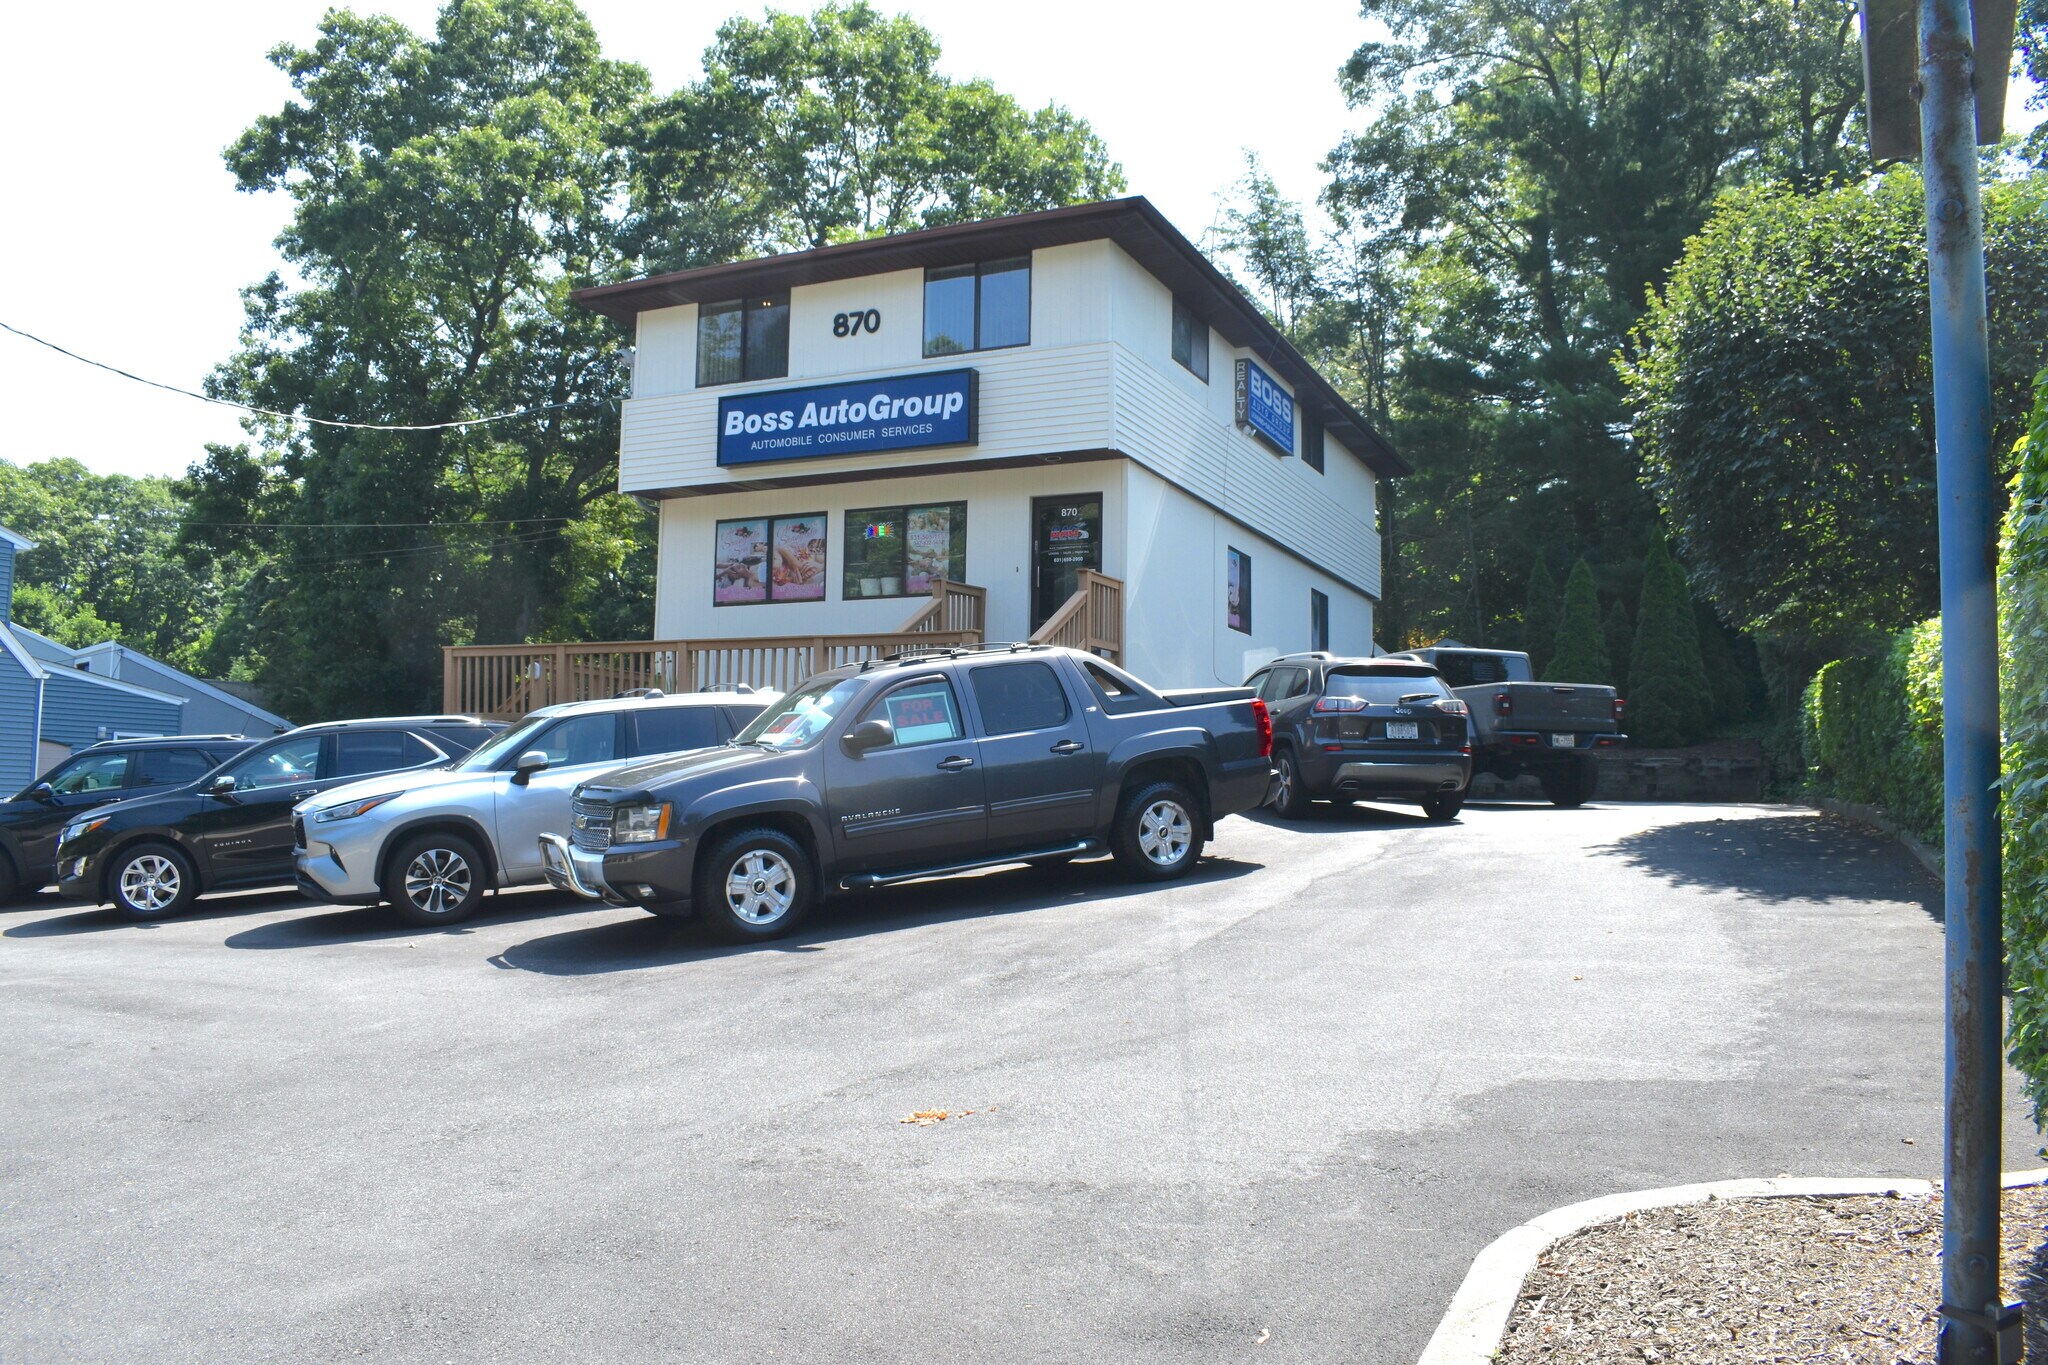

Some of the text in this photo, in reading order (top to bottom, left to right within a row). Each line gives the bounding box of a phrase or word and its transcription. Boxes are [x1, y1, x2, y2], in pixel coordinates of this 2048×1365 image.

[832, 308, 881, 338] 870
[1236, 361, 1246, 419] REALTY
[1250, 368, 1292, 424] BOSS
[798, 391, 964, 428] AutoGroup
[750, 422, 933, 451] AUTOMOBILE CONSUMER SERVICES
[1060, 507, 1079, 517] 870
[901, 699, 933, 713] FOR
[1395, 707, 1412, 715] Jeep
[896, 709, 945, 727] SALE
[841, 808, 901, 822] AVALANCHE
